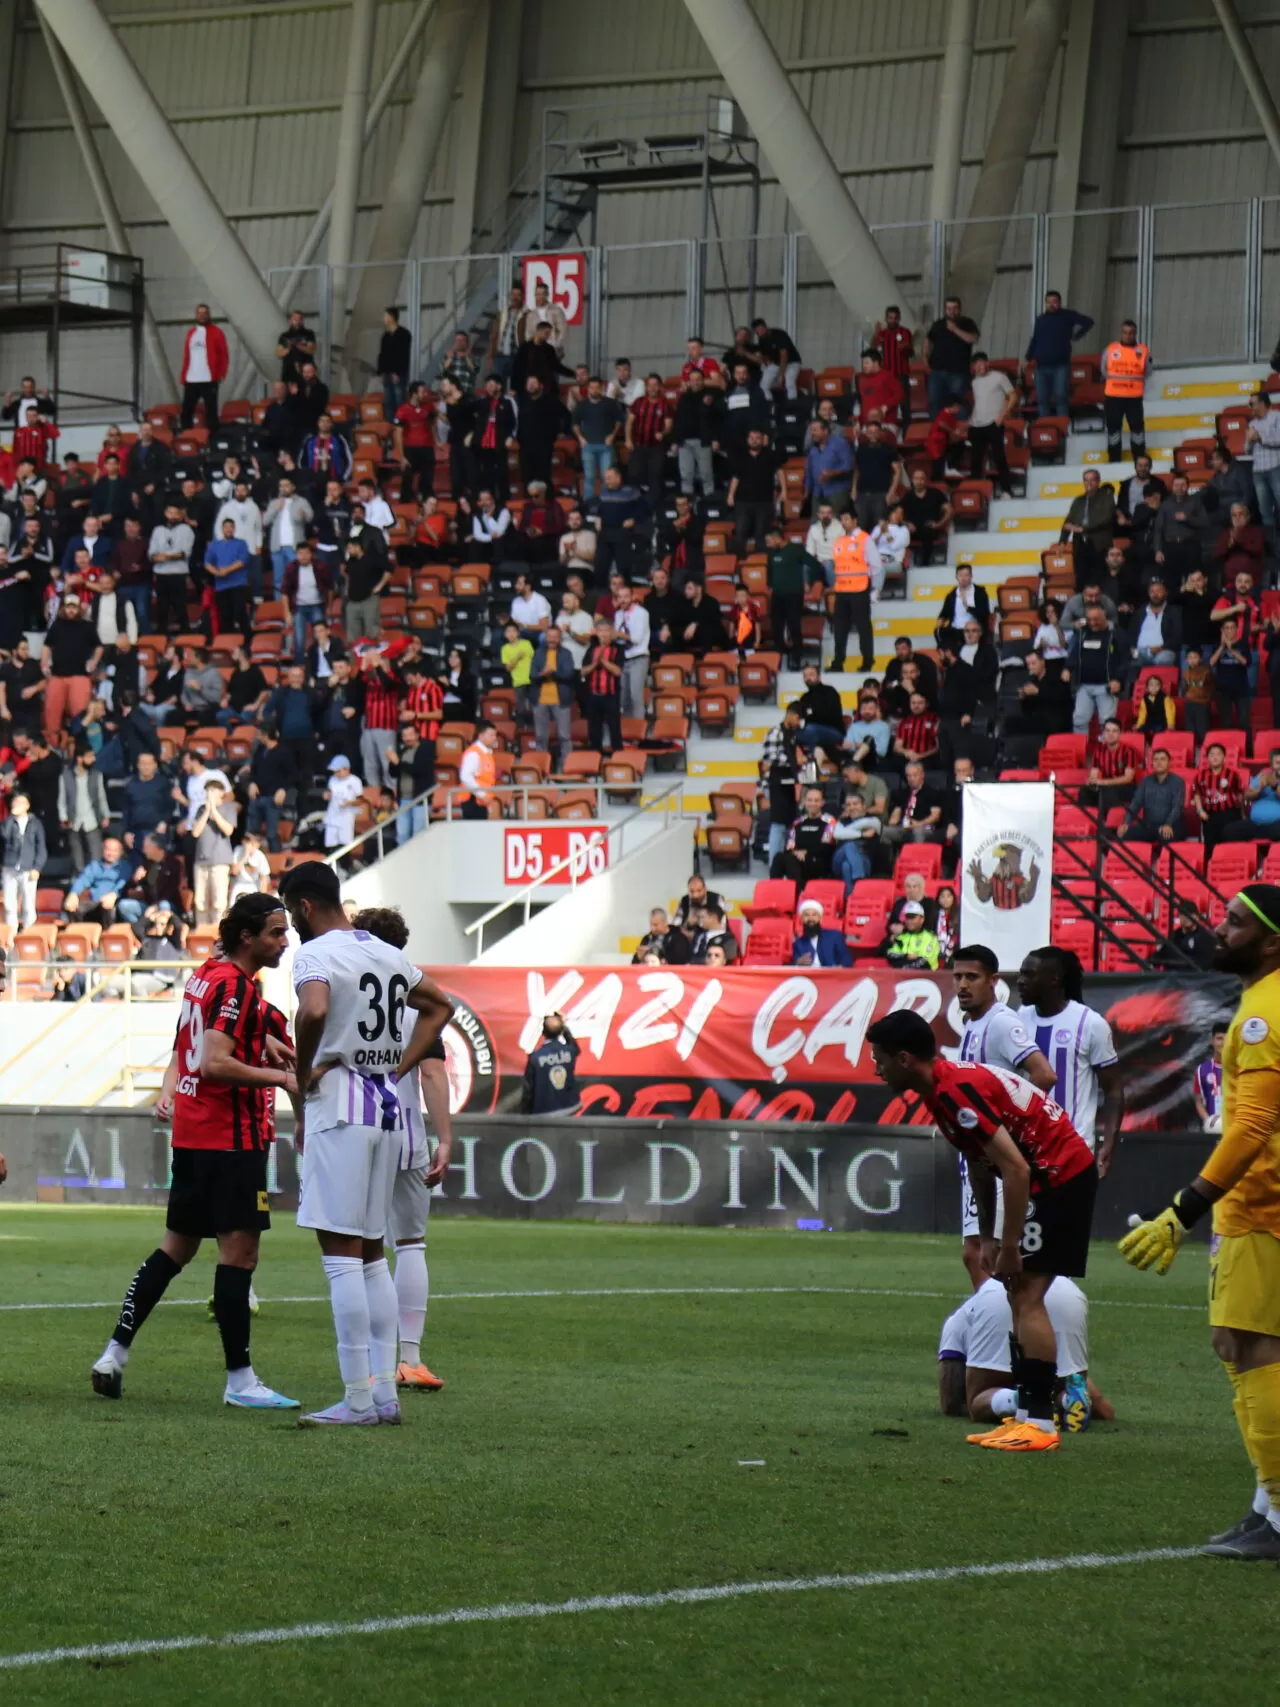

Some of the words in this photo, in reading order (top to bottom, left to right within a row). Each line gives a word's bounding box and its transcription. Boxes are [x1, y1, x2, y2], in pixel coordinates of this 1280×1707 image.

[525, 258, 580, 321] D5
[506, 832, 544, 880] D5
[567, 830, 606, 878] D6
[357, 972, 409, 1042] 36
[520, 969, 723, 1062] YAZI
[354, 1049, 402, 1066] ORHAN
